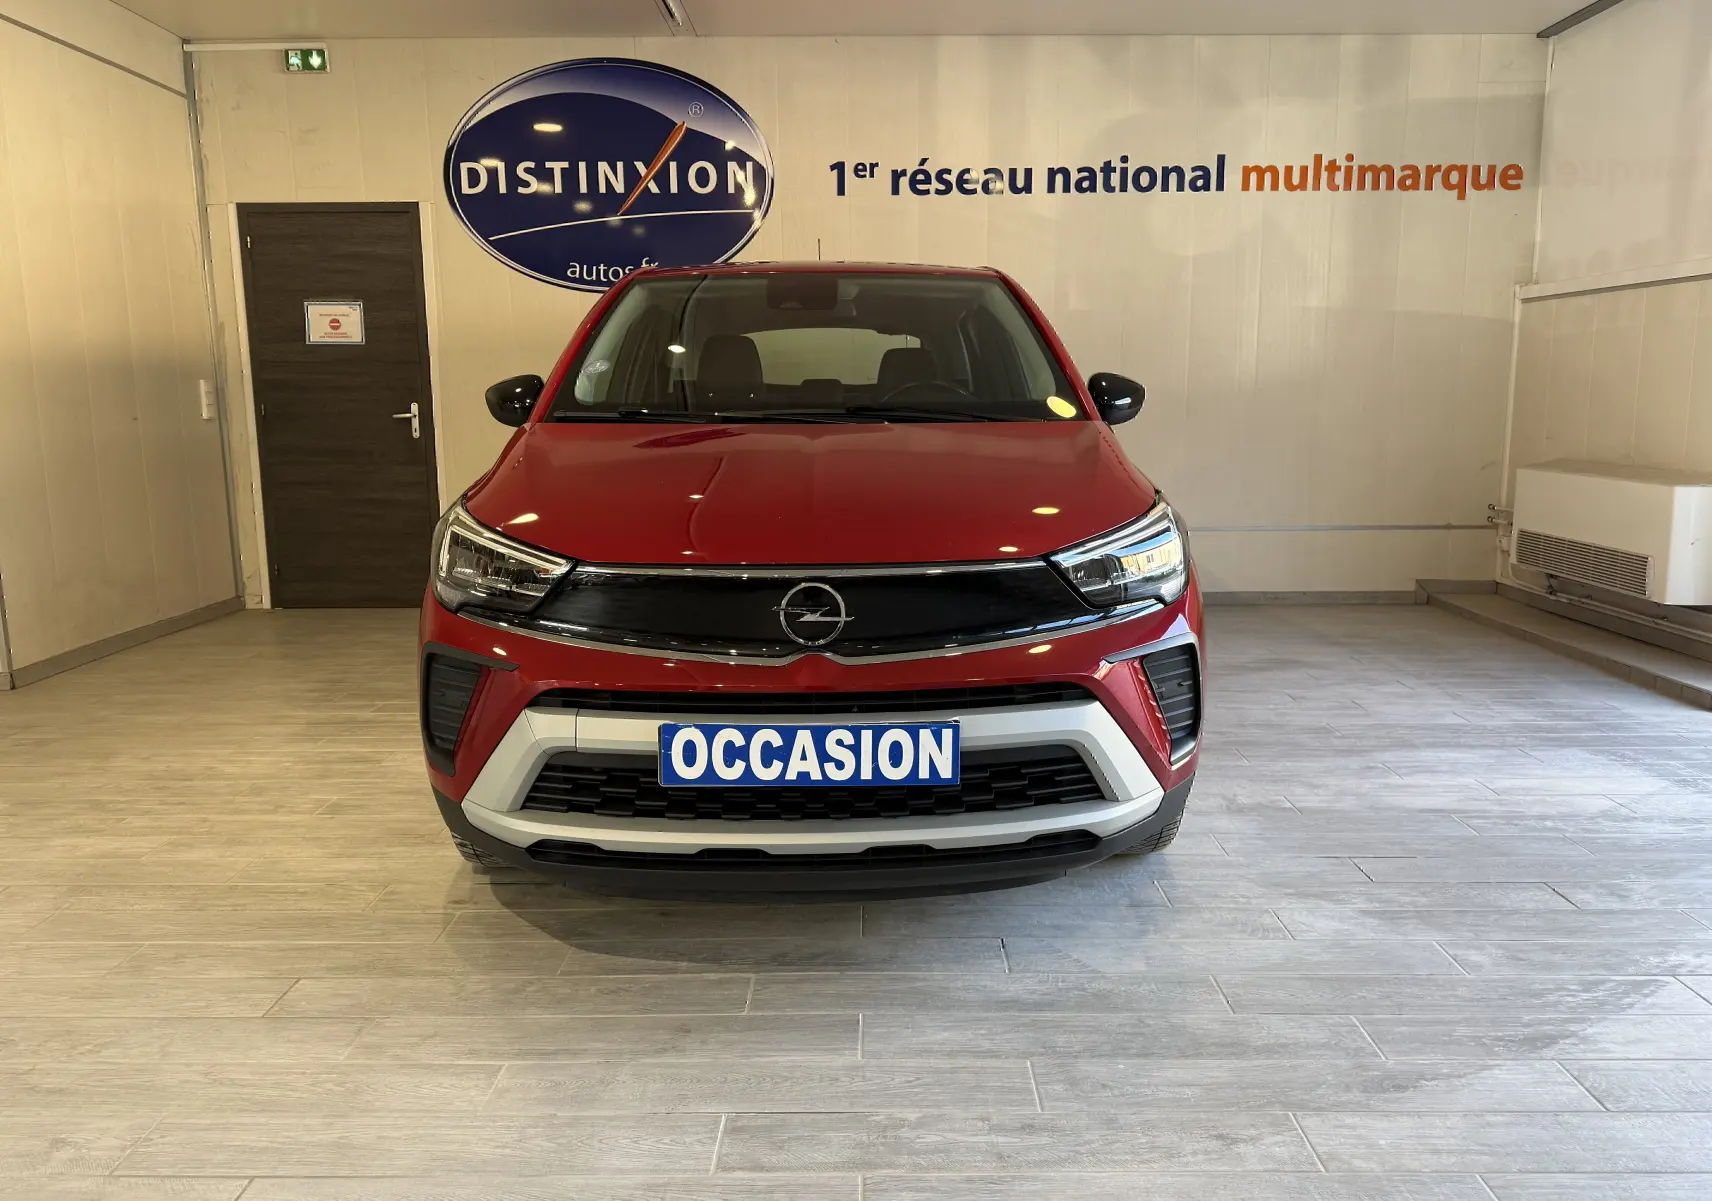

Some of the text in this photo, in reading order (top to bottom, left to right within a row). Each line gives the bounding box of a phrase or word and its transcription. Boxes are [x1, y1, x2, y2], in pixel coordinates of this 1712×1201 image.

[459, 161, 753, 194] DISTINXION
[890, 157, 1033, 196] réseau
[1047, 154, 1226, 193] national
[1241, 153, 1524, 201] multimarque
[671, 727, 953, 780] OCCASION
